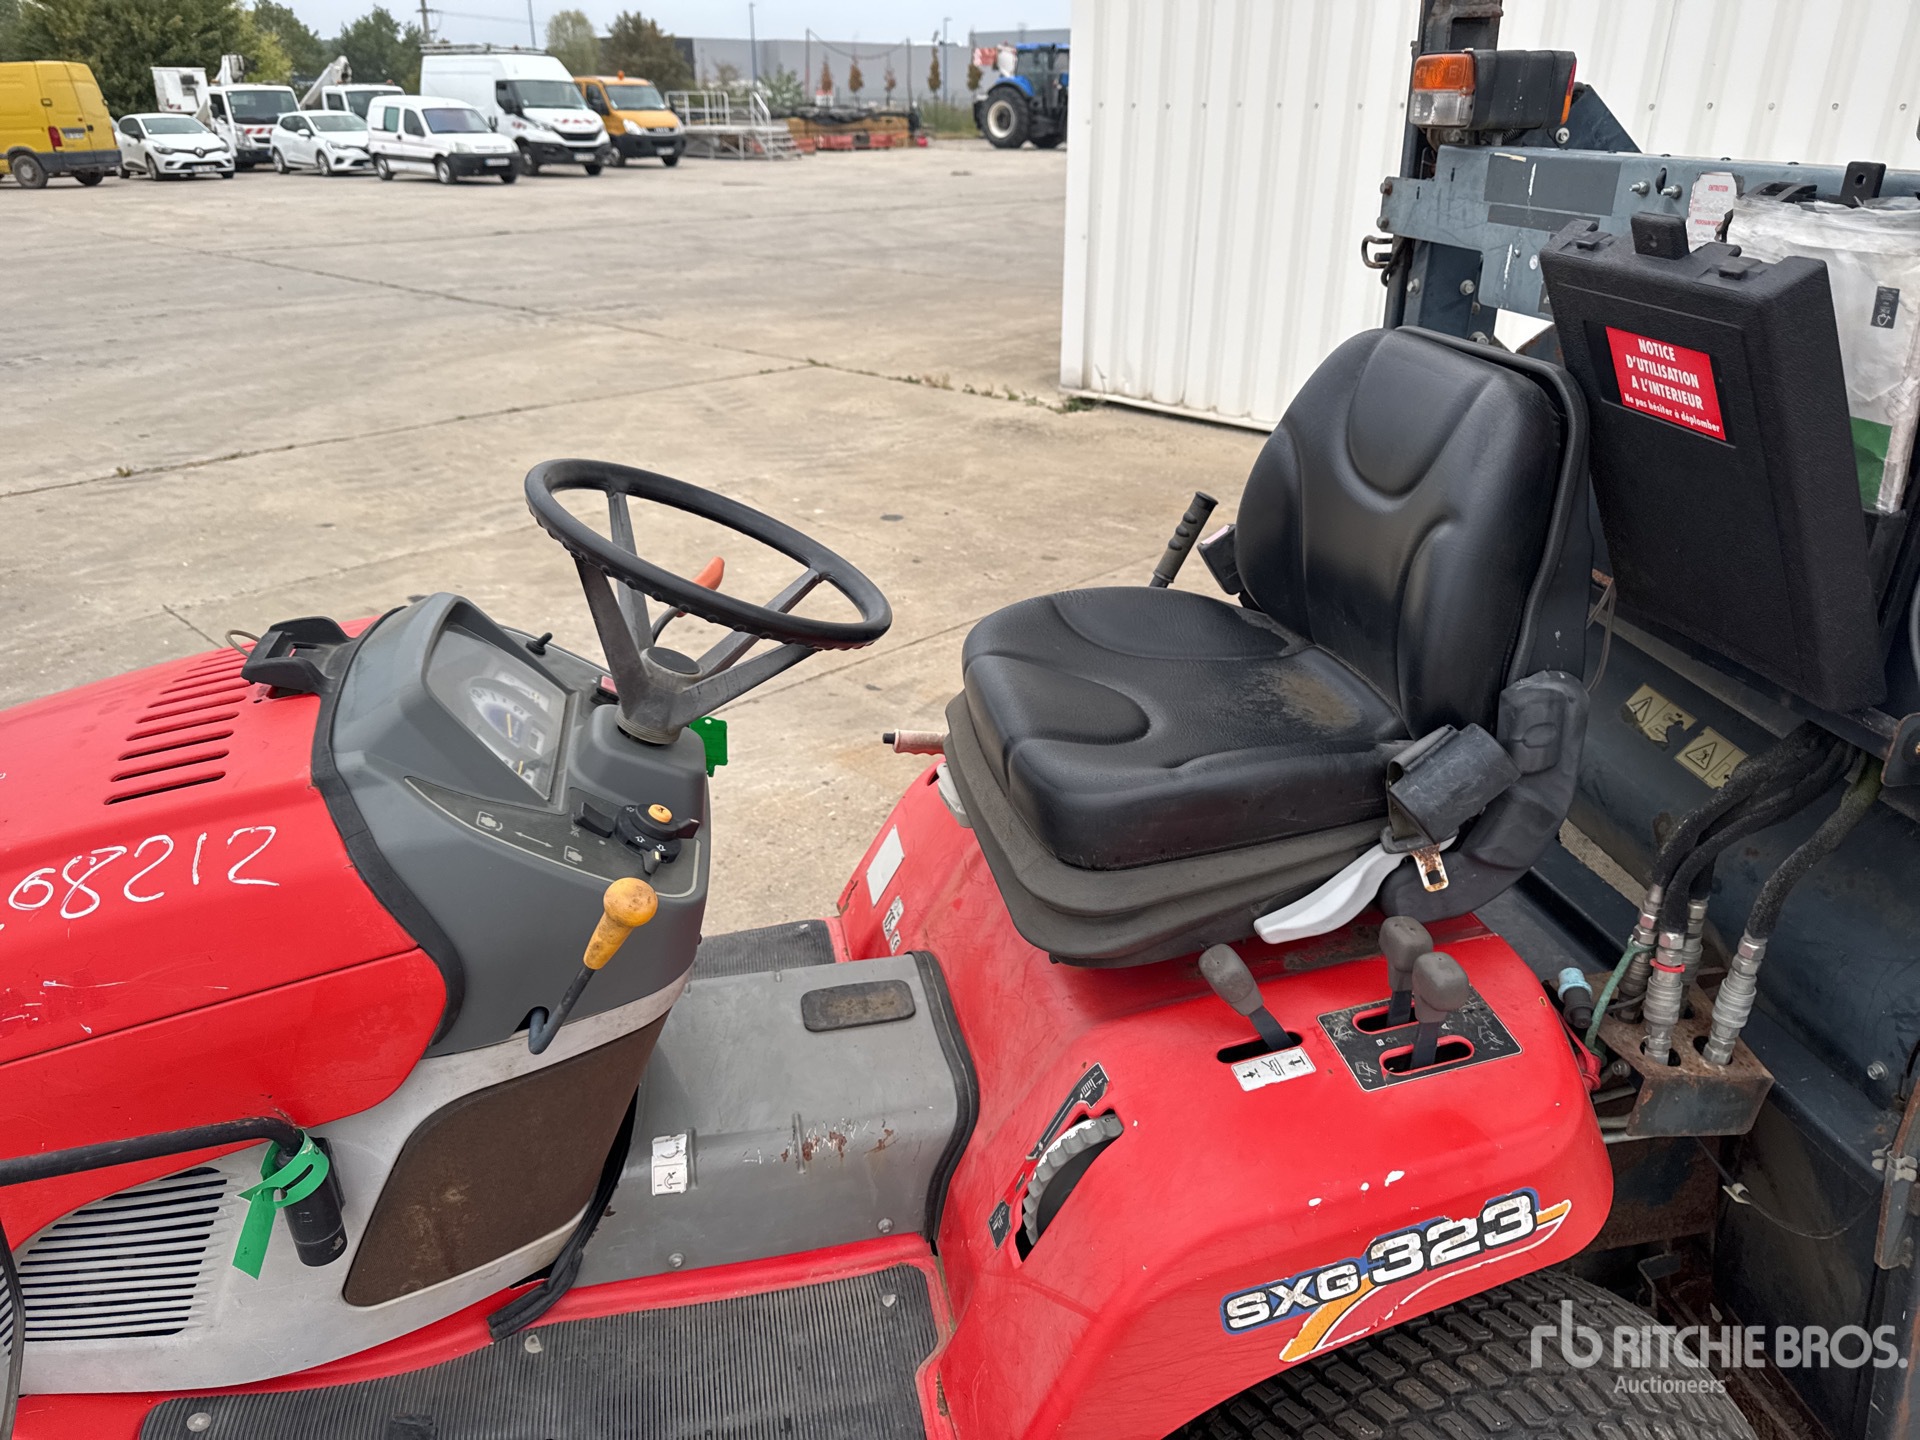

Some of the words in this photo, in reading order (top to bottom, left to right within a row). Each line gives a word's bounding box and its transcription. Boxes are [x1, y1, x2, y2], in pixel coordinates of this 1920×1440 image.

[1638, 338, 1676, 362] NOTICE
[1625, 354, 1700, 389] D'UTILISATION
[1631, 375, 1639, 390] A
[1640, 377, 1704, 411] L'INTERIEUR
[1624, 392, 1634, 404] Ne
[1635, 397, 1648, 408] pas
[1648, 399, 1673, 416] hésiter
[1674, 408, 1680, 419] à
[1680, 411, 1720, 433] déplomber
[1225, 1262, 1361, 1331] SXG
[1368, 1192, 1538, 1285] 323
